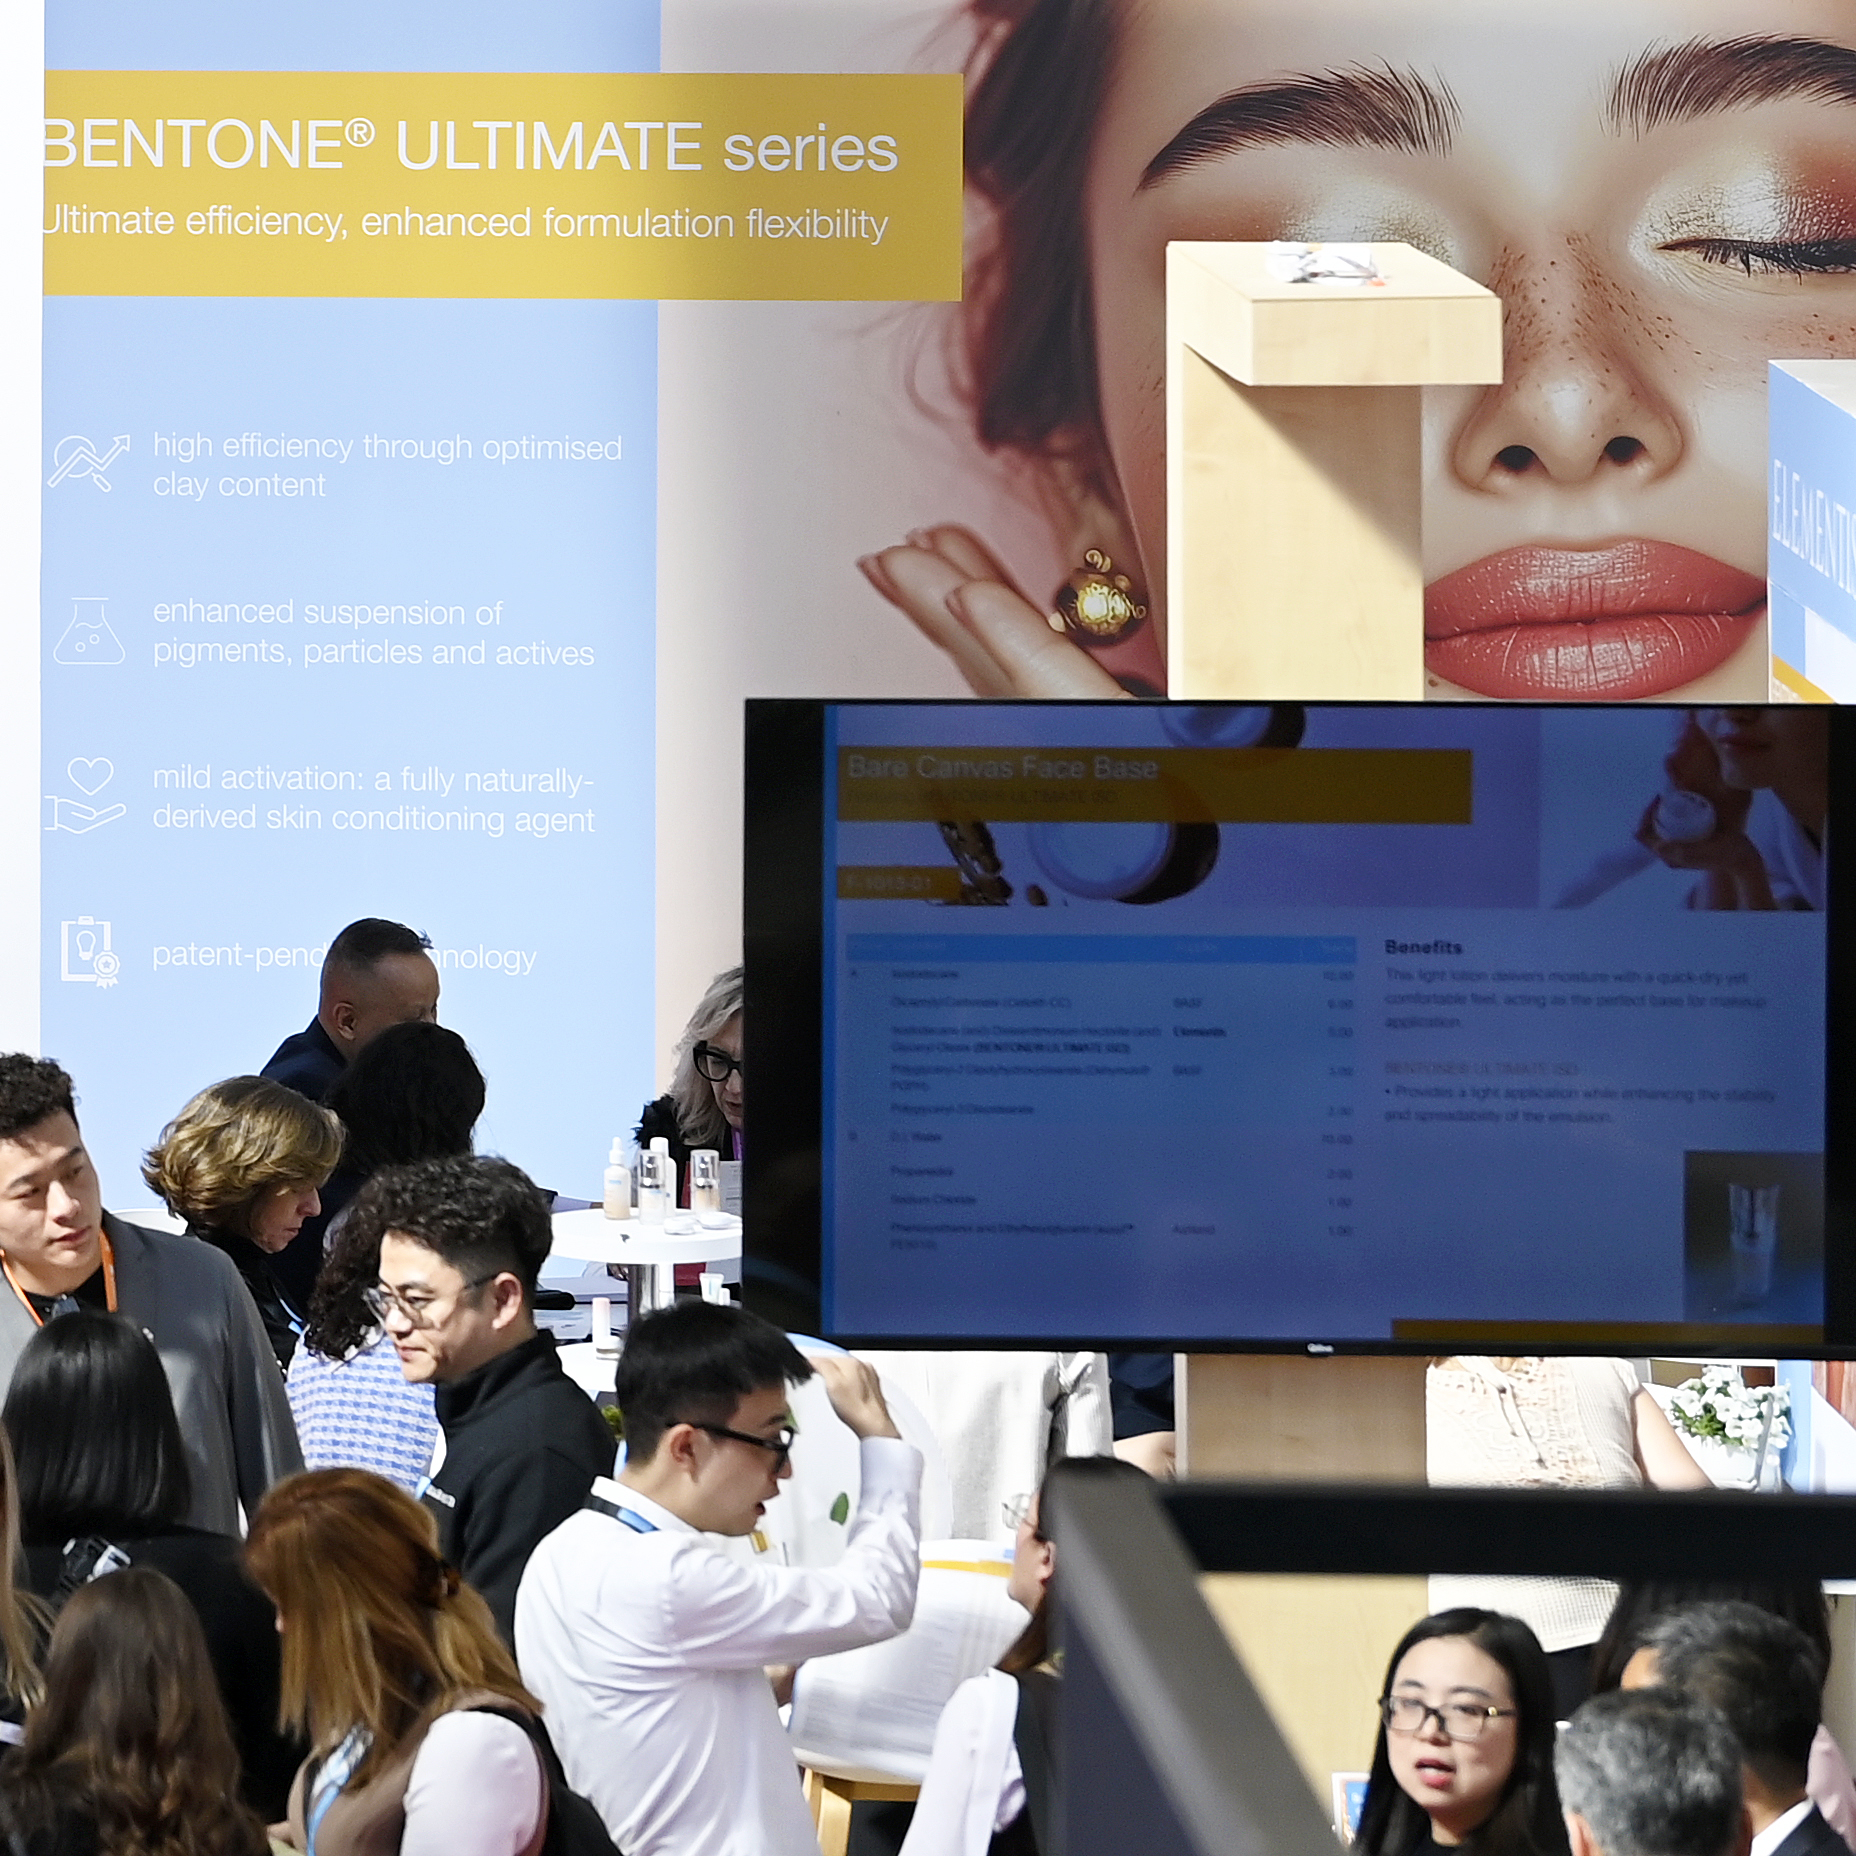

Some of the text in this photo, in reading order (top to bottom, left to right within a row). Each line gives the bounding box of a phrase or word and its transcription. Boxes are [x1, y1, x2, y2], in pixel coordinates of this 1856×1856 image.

[397, 120, 703, 171] ULTIMATE
[724, 123, 898, 171] series
[43, 203, 888, 245] Ultimate efficiency, enhanced formulation flexibility
[155, 432, 623, 465] high efficiency through optimised
[154, 471, 327, 501] clay content
[1773, 457, 1856, 601] ELEMENTI
[154, 598, 503, 629] enhanced suspension of
[155, 637, 594, 668] pigments, particles and actives
[154, 764, 593, 798] mild activation: a fully naturally-
[848, 755, 1159, 780] Bare Canvas Face Base
[154, 803, 595, 838] derived skin conditioning agent
[151, 940, 538, 977] patent-pend nology
